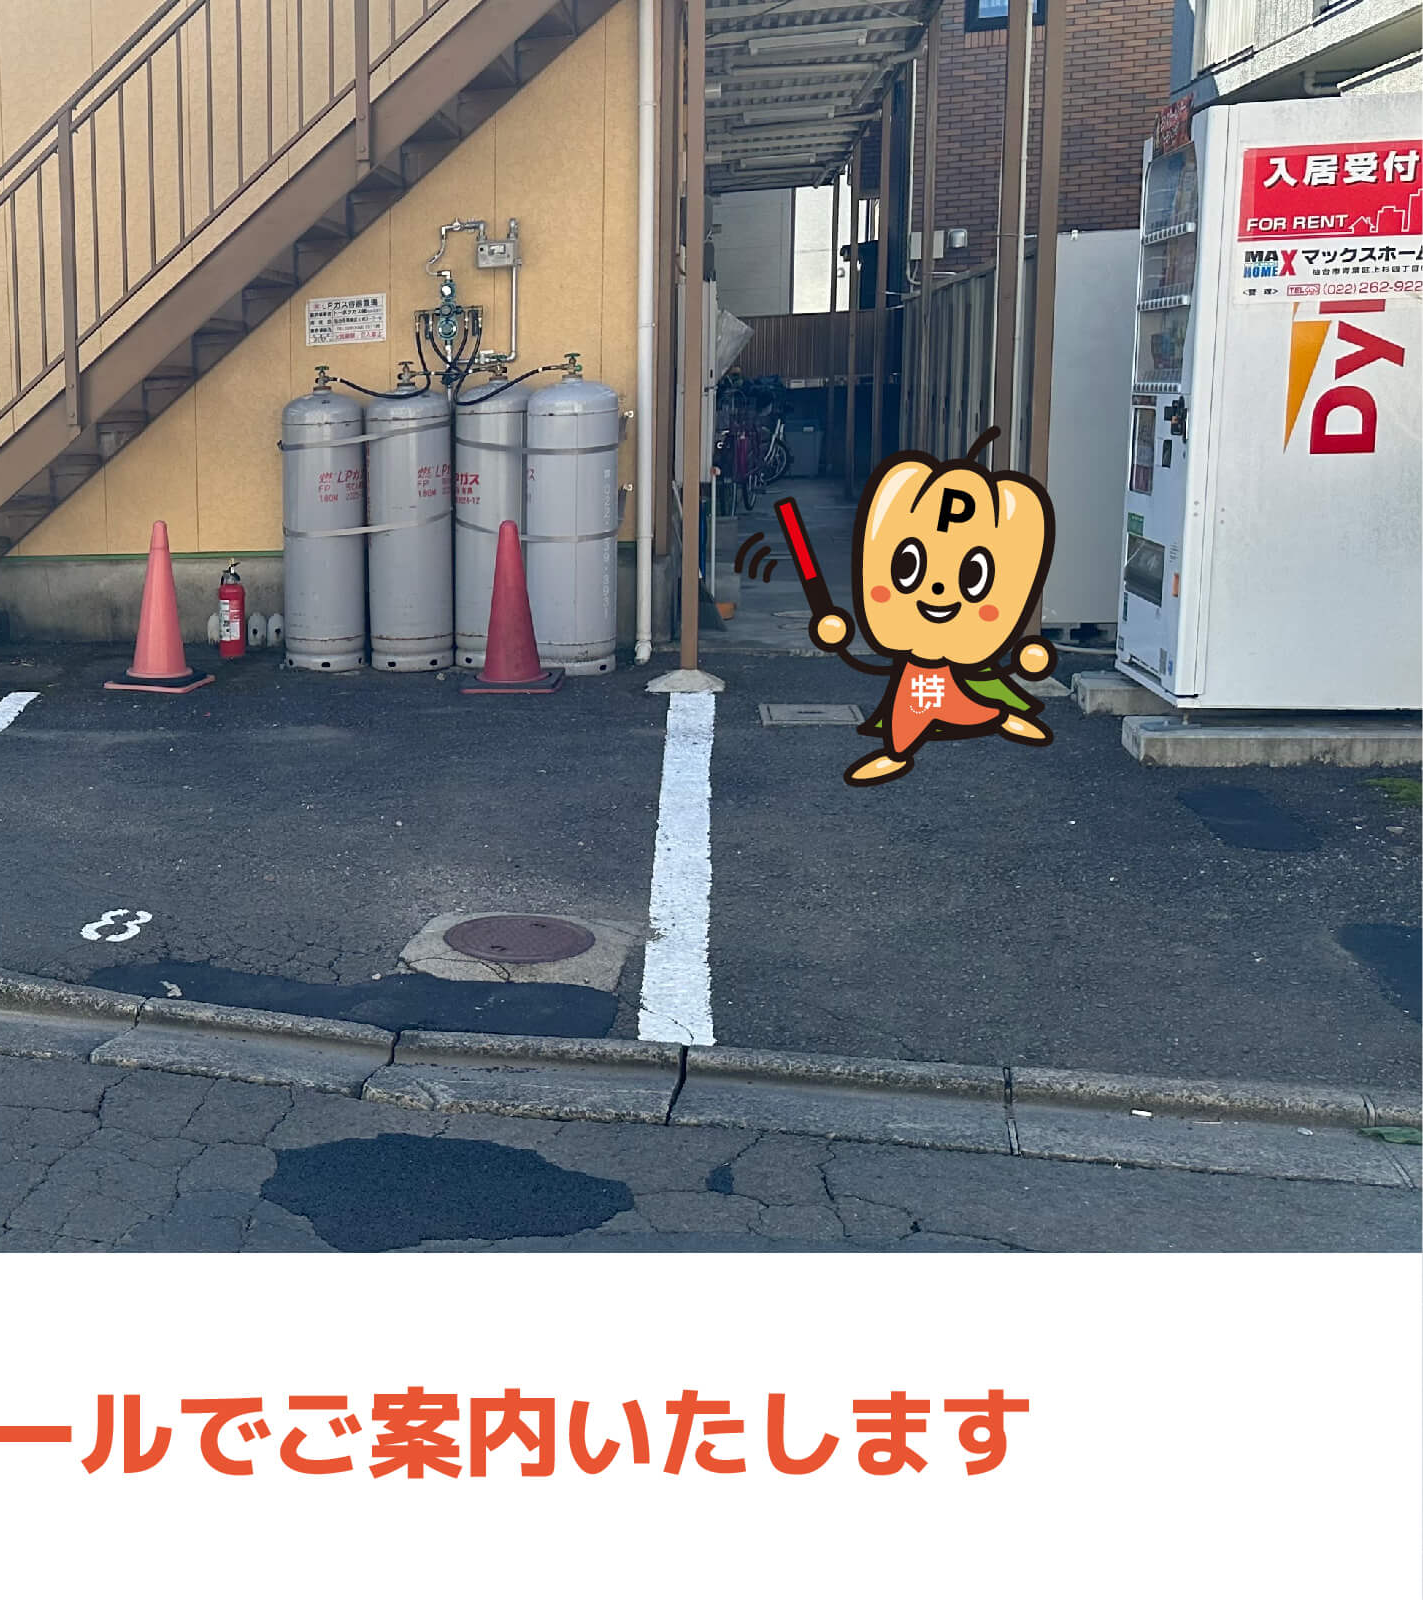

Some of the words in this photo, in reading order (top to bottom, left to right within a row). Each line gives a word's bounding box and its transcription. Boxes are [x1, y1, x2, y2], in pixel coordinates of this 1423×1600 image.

[1263, 149, 1420, 189] 入居受付
[1246, 217, 1287, 232] FOR
[1293, 214, 1349, 230] RENT
[1243, 264, 1279, 278] HOME
[1244, 249, 1298, 276] MAX
[1309, 299, 1405, 454] Dy
[80, 908, 153, 942] 8
